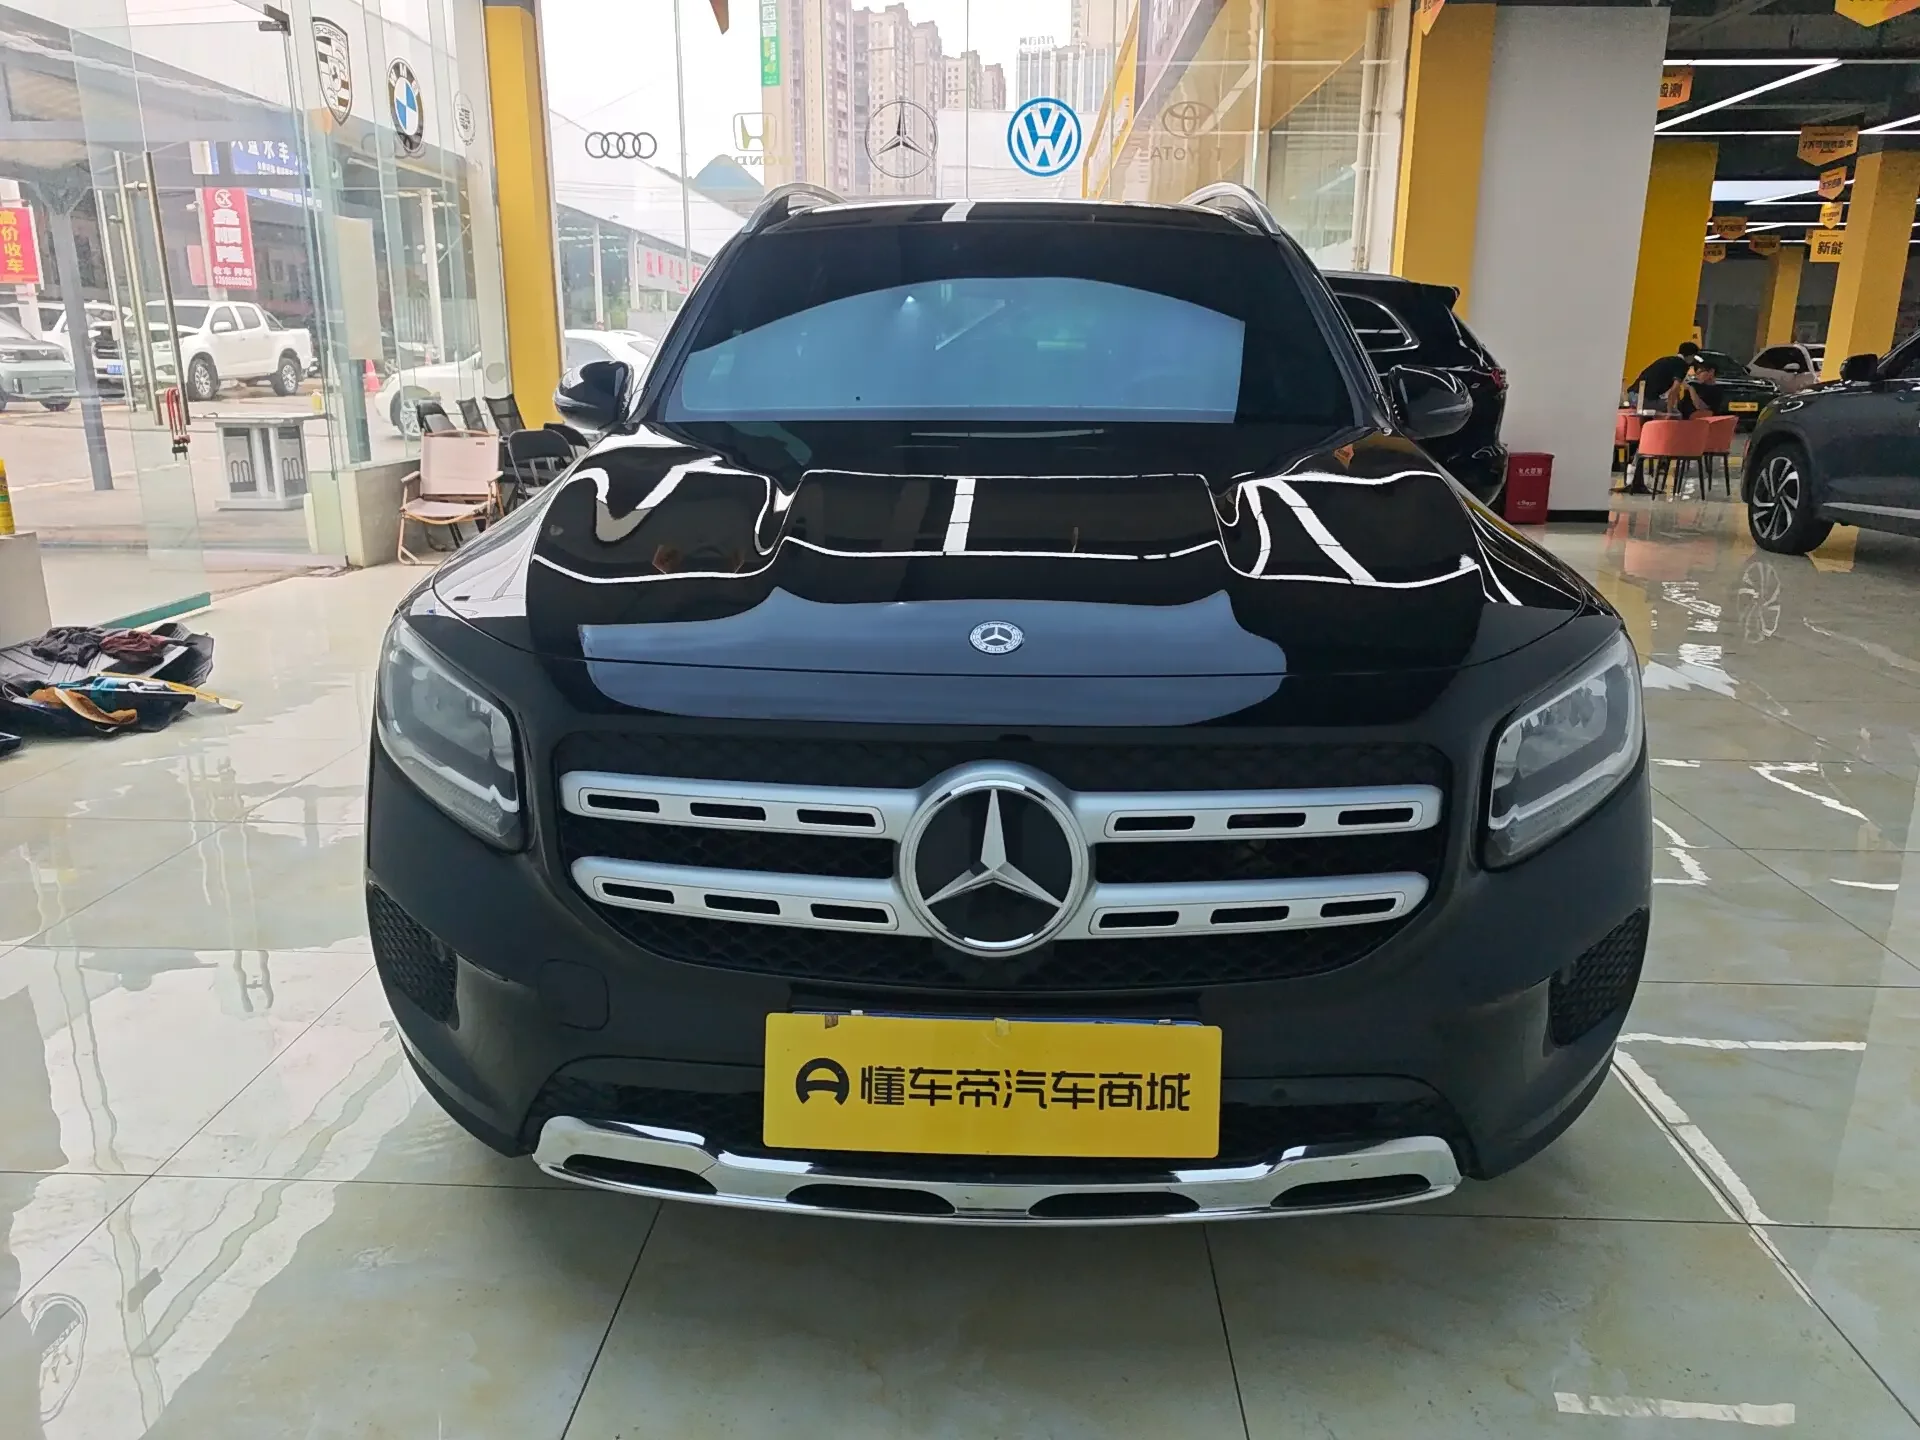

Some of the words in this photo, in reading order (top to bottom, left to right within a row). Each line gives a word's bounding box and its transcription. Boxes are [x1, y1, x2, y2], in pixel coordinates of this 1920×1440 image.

[860, 1064, 1192, 1112] 懂车帝汽车商城
